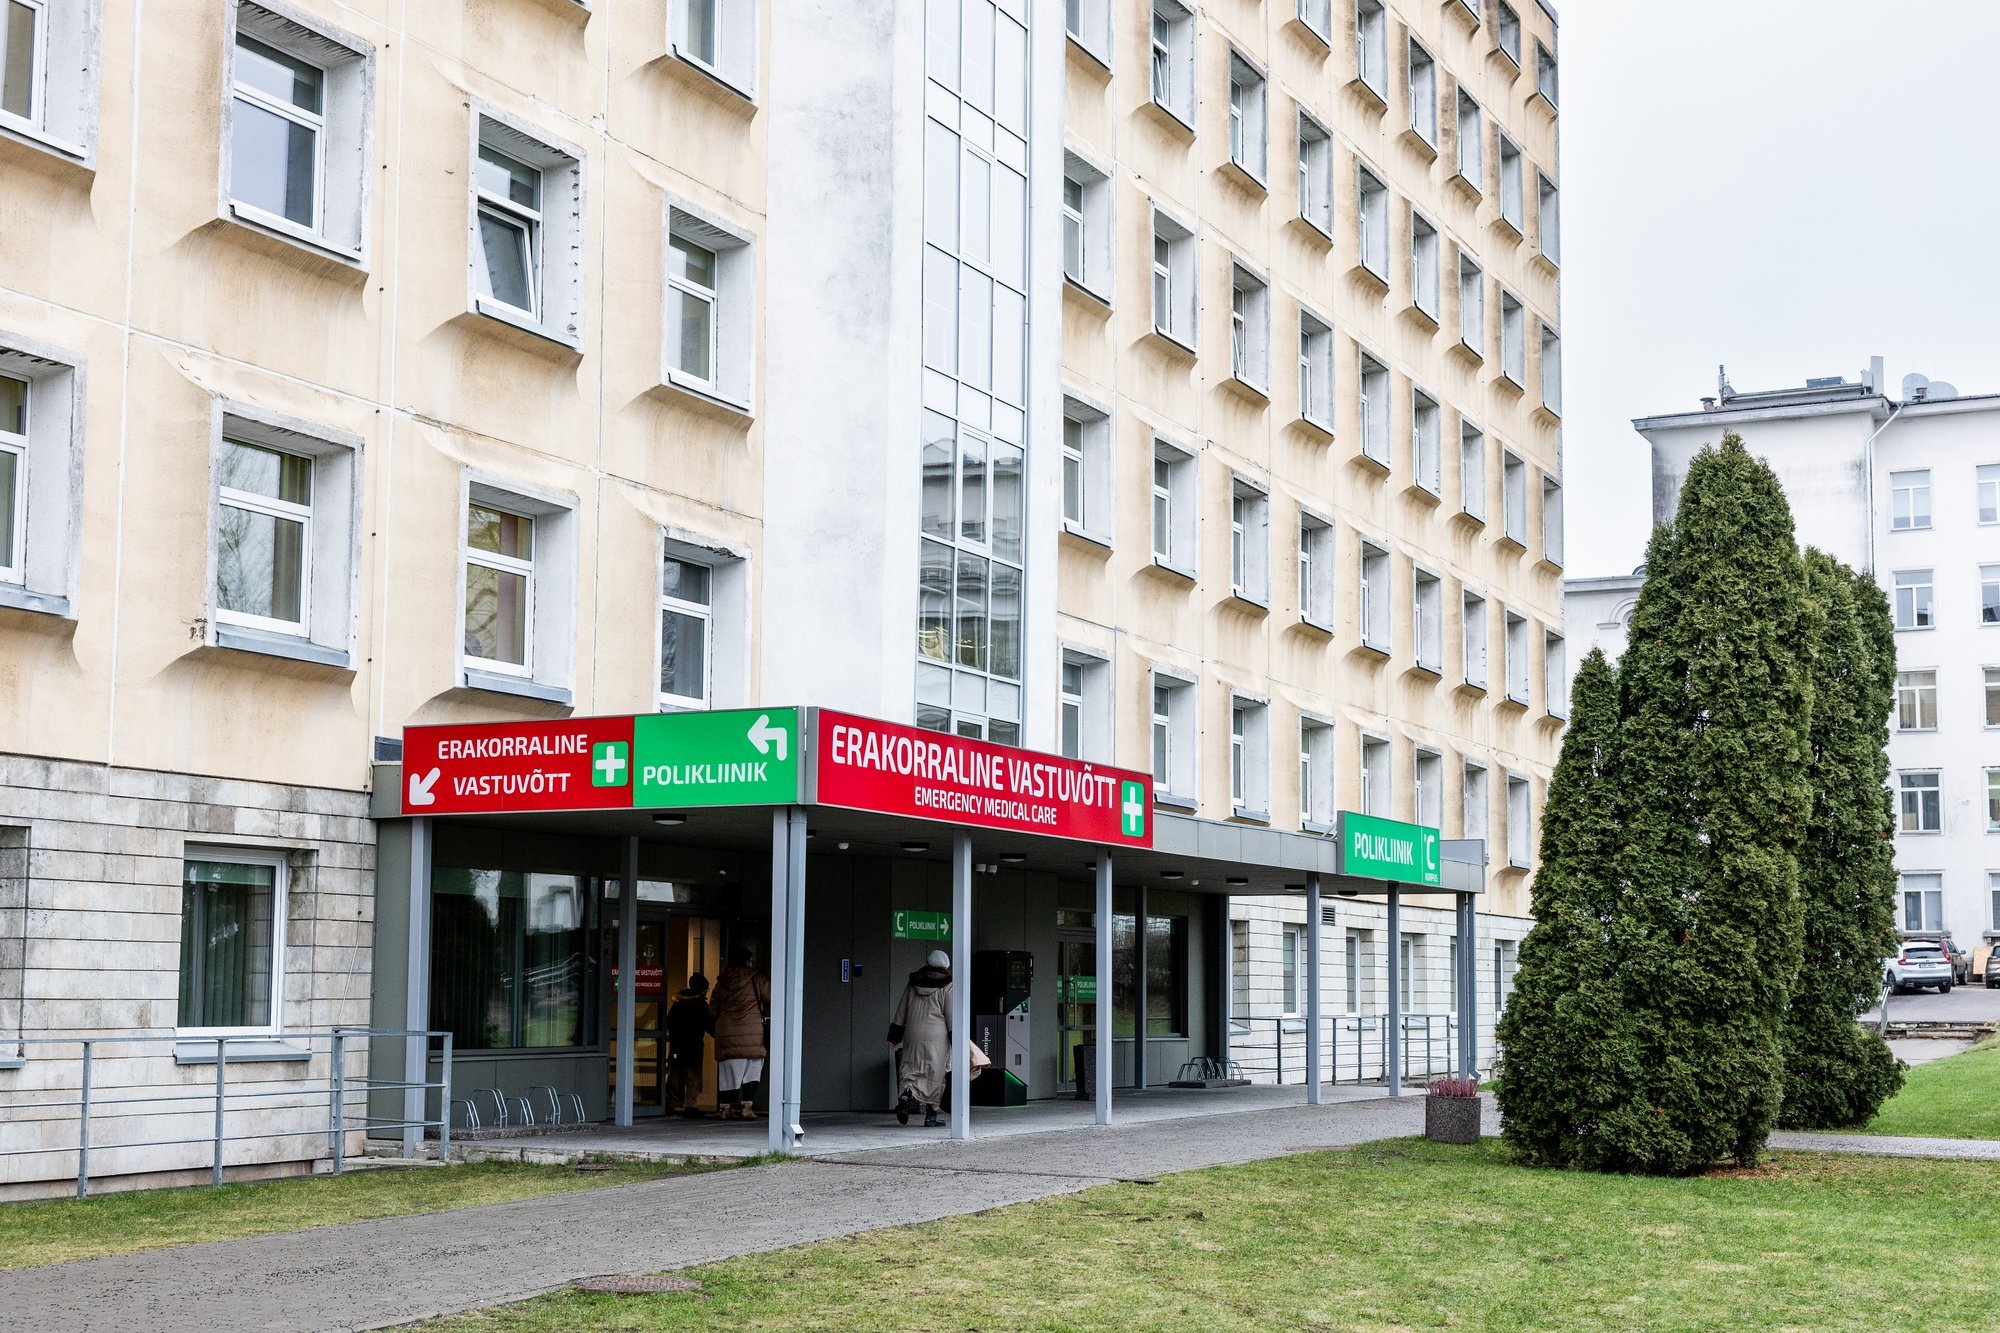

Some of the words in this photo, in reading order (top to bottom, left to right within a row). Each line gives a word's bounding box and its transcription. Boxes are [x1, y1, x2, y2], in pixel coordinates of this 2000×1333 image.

[438, 734, 588, 760] ERAKORRALINE
[643, 761, 768, 786] POLIKLIINIK
[832, 725, 1004, 791] ERAKORRALINE
[1007, 764, 1116, 809] VASTUVÕTT
[453, 768, 571, 796] VASTUVÕTT
[914, 786, 983, 815] EMERGENCY
[984, 797, 1030, 822] MEDICAL
[1031, 806, 1057, 826] CARE
[1354, 832, 1414, 866] POLIKLIINIK
[909, 921, 936, 931] POLIKLIINIK
